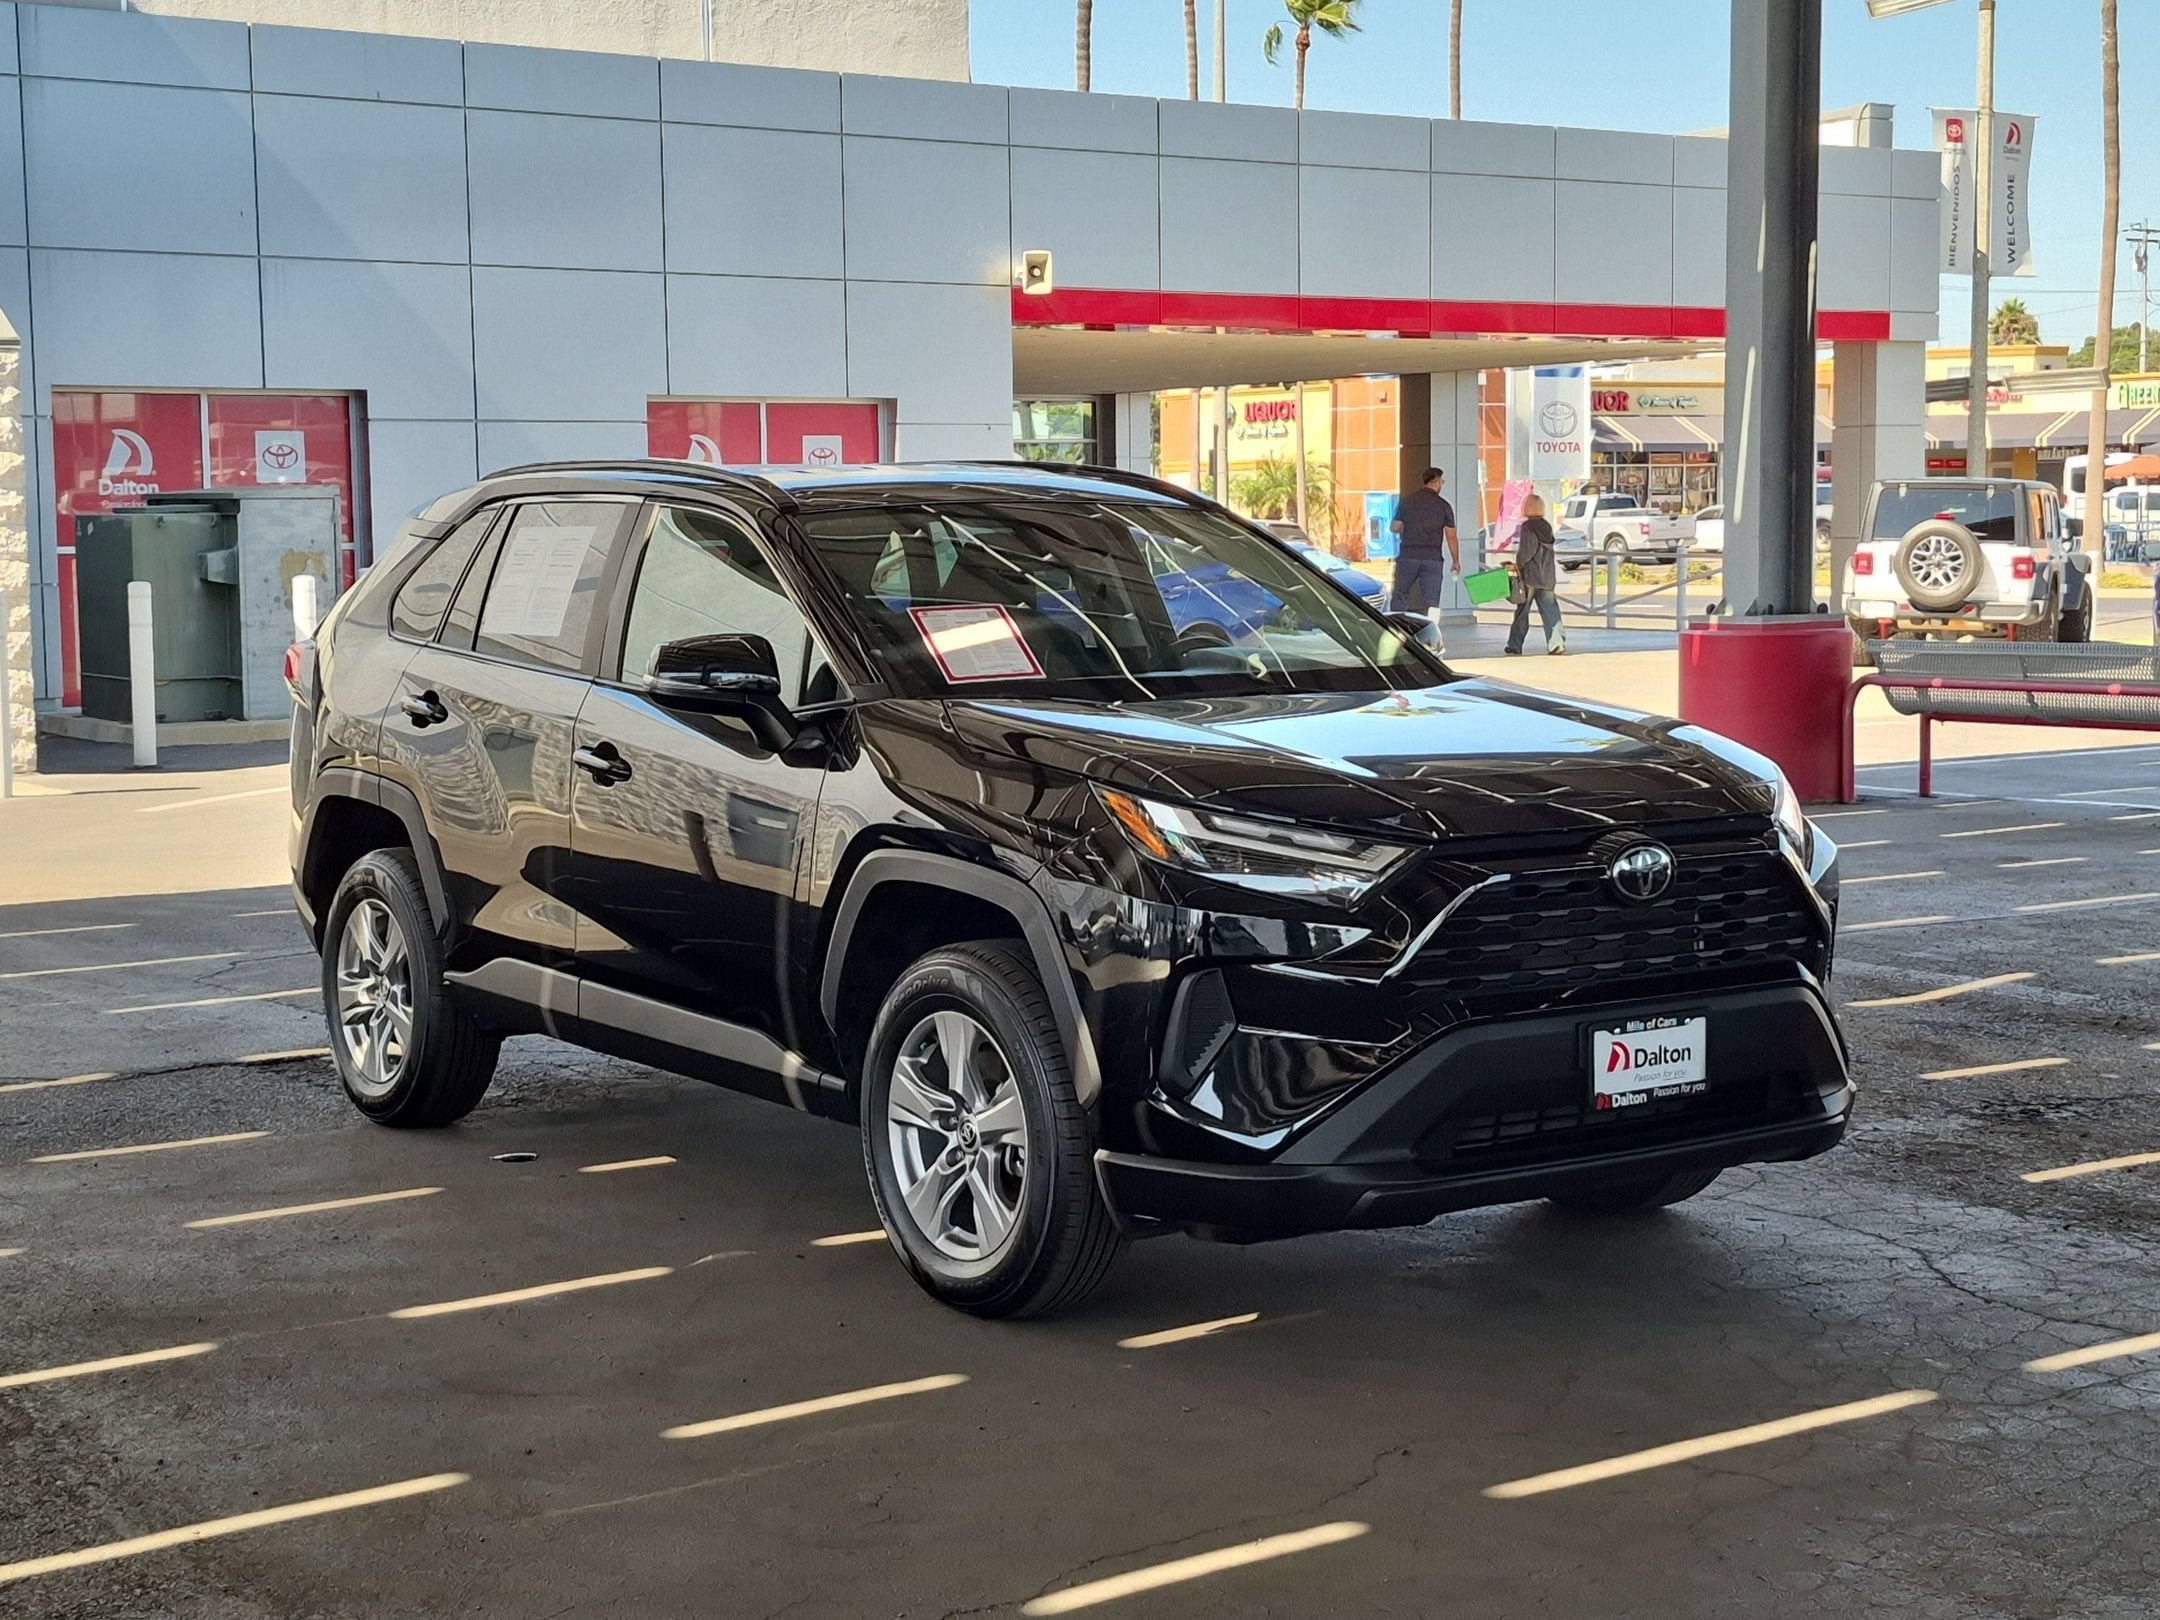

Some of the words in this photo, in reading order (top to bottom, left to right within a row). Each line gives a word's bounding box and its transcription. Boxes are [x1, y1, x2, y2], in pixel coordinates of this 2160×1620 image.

[1948, 165, 1961, 267] BIENVENIDOS
[2006, 174, 2016, 265] WELCOME
[1535, 441, 1581, 454] TOYOTA
[98, 478, 159, 496] Dalton
[1626, 1020, 1645, 1032] Mile
[1646, 1018, 1657, 1030] of
[1657, 1017, 1678, 1028] Cars
[1634, 1044, 1692, 1068] Dalton
[1633, 1072, 1661, 1083] Passion
[1662, 1070, 1673, 1081] for
[1674, 1068, 1688, 1079] you
[1653, 1086, 1680, 1098] Passion
[1680, 1083, 1692, 1094] for
[1692, 1082, 1706, 1094] you
[1611, 1092, 1648, 1108] Dalton
